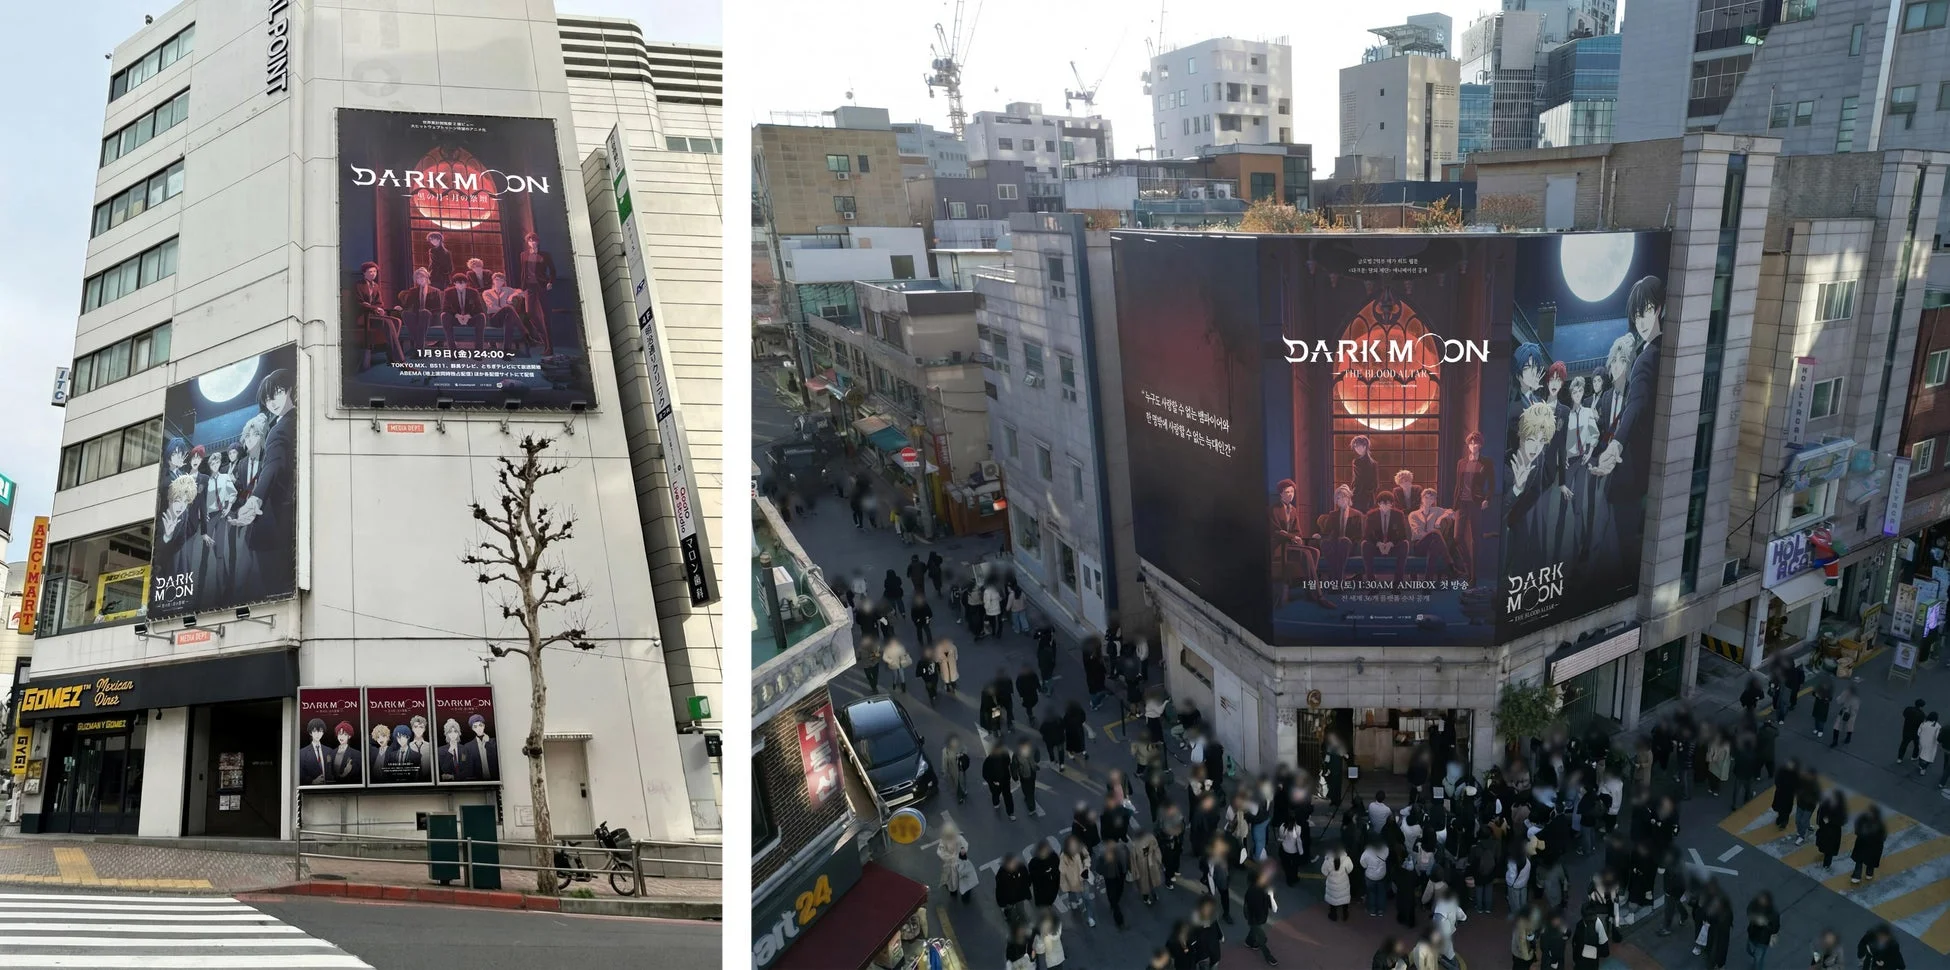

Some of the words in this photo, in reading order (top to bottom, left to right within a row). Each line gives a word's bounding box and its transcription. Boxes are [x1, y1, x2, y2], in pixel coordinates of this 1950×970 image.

[350, 162, 449, 189] DARK
[452, 169, 550, 196] MOON
[1282, 334, 1383, 364] DARK
[1386, 332, 1491, 368] MOON
[1344, 369, 1363, 378] THE
[1365, 369, 1396, 378] BLOOD
[1398, 369, 1428, 378] ALTAR
[55, 370, 66, 400] ITC
[677, 501, 686, 534] Studio
[23, 524, 46, 625] ABC-MART
[155, 571, 194, 590] DARK
[1508, 562, 1564, 595] DARK
[155, 584, 194, 602] MOON
[1302, 580, 1317, 590] 1월
[1319, 580, 1339, 590] 10일
[1340, 580, 1356, 590] (토)
[1358, 580, 1393, 589] 1:30AM
[1397, 580, 1436, 589] ANIBOX
[1440, 580, 1449, 590] 첫
[1451, 581, 1469, 590] 방송
[1506, 580, 1564, 614] MOON
[180, 633, 195, 642] MEDIA
[96, 677, 134, 693] Mexican
[94, 692, 120, 707] Diner
[302, 701, 329, 710] DARK
[330, 699, 357, 710] MOON
[370, 700, 397, 709] DARK
[397, 698, 425, 709] MOON
[436, 699, 463, 708] DARK
[464, 698, 491, 708] MOON
[77, 721, 101, 731] GUZMAN
[106, 719, 126, 729] GOMEZ
[14, 736, 29, 769] GYG!
